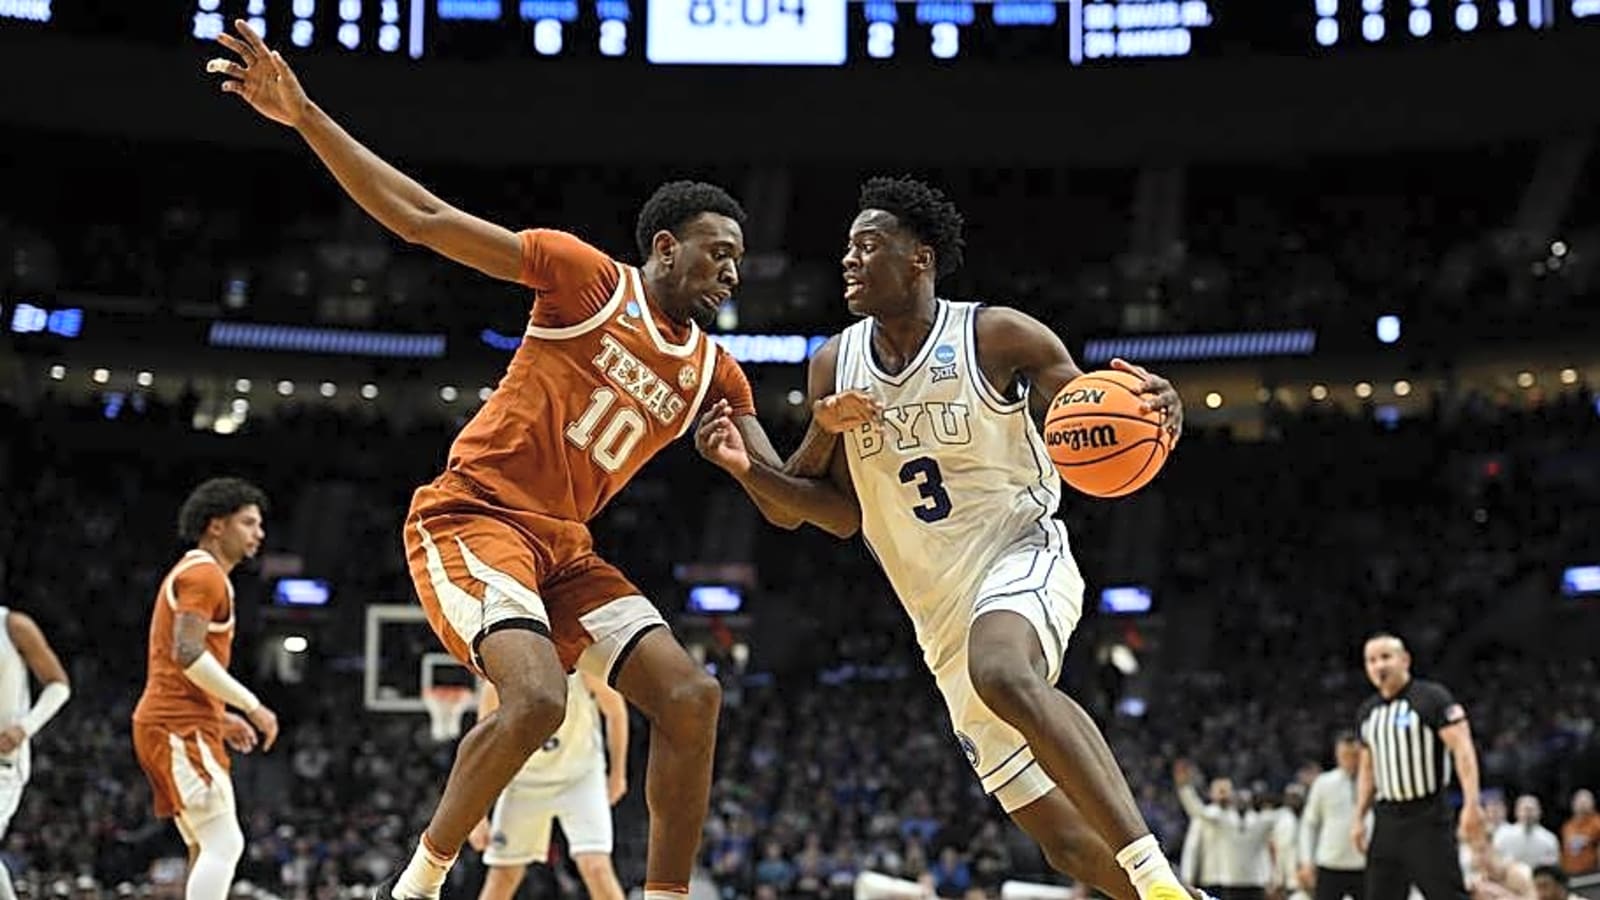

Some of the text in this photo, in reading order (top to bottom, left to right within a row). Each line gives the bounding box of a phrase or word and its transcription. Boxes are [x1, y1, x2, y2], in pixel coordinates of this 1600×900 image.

[591, 332, 687, 426] TEXAS
[568, 386, 648, 473] 10
[851, 402, 972, 460] BYU
[1047, 423, 1119, 451] Wilson
[899, 456, 952, 523] 3
